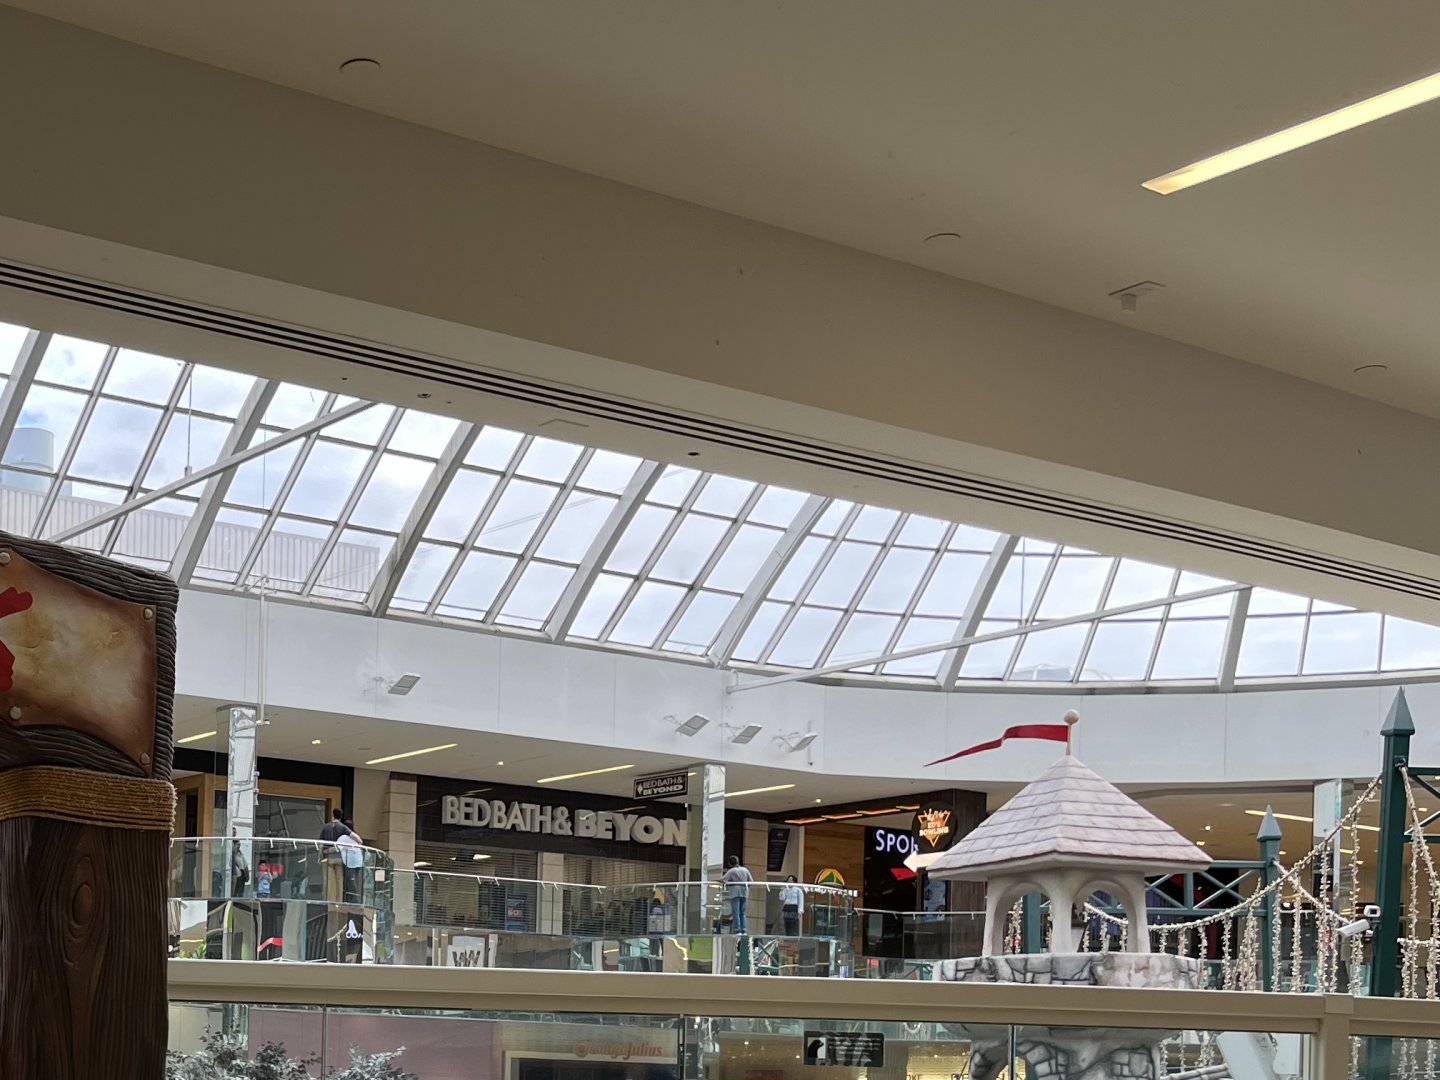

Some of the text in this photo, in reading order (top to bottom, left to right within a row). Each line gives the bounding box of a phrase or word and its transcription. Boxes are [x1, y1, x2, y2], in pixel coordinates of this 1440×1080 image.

[643, 785, 683, 795] BEYOND
[442, 795, 687, 847] BED BATH & BEYON
[919, 826, 949, 837] BOWLING
[623, 1042, 664, 1060] Julius
